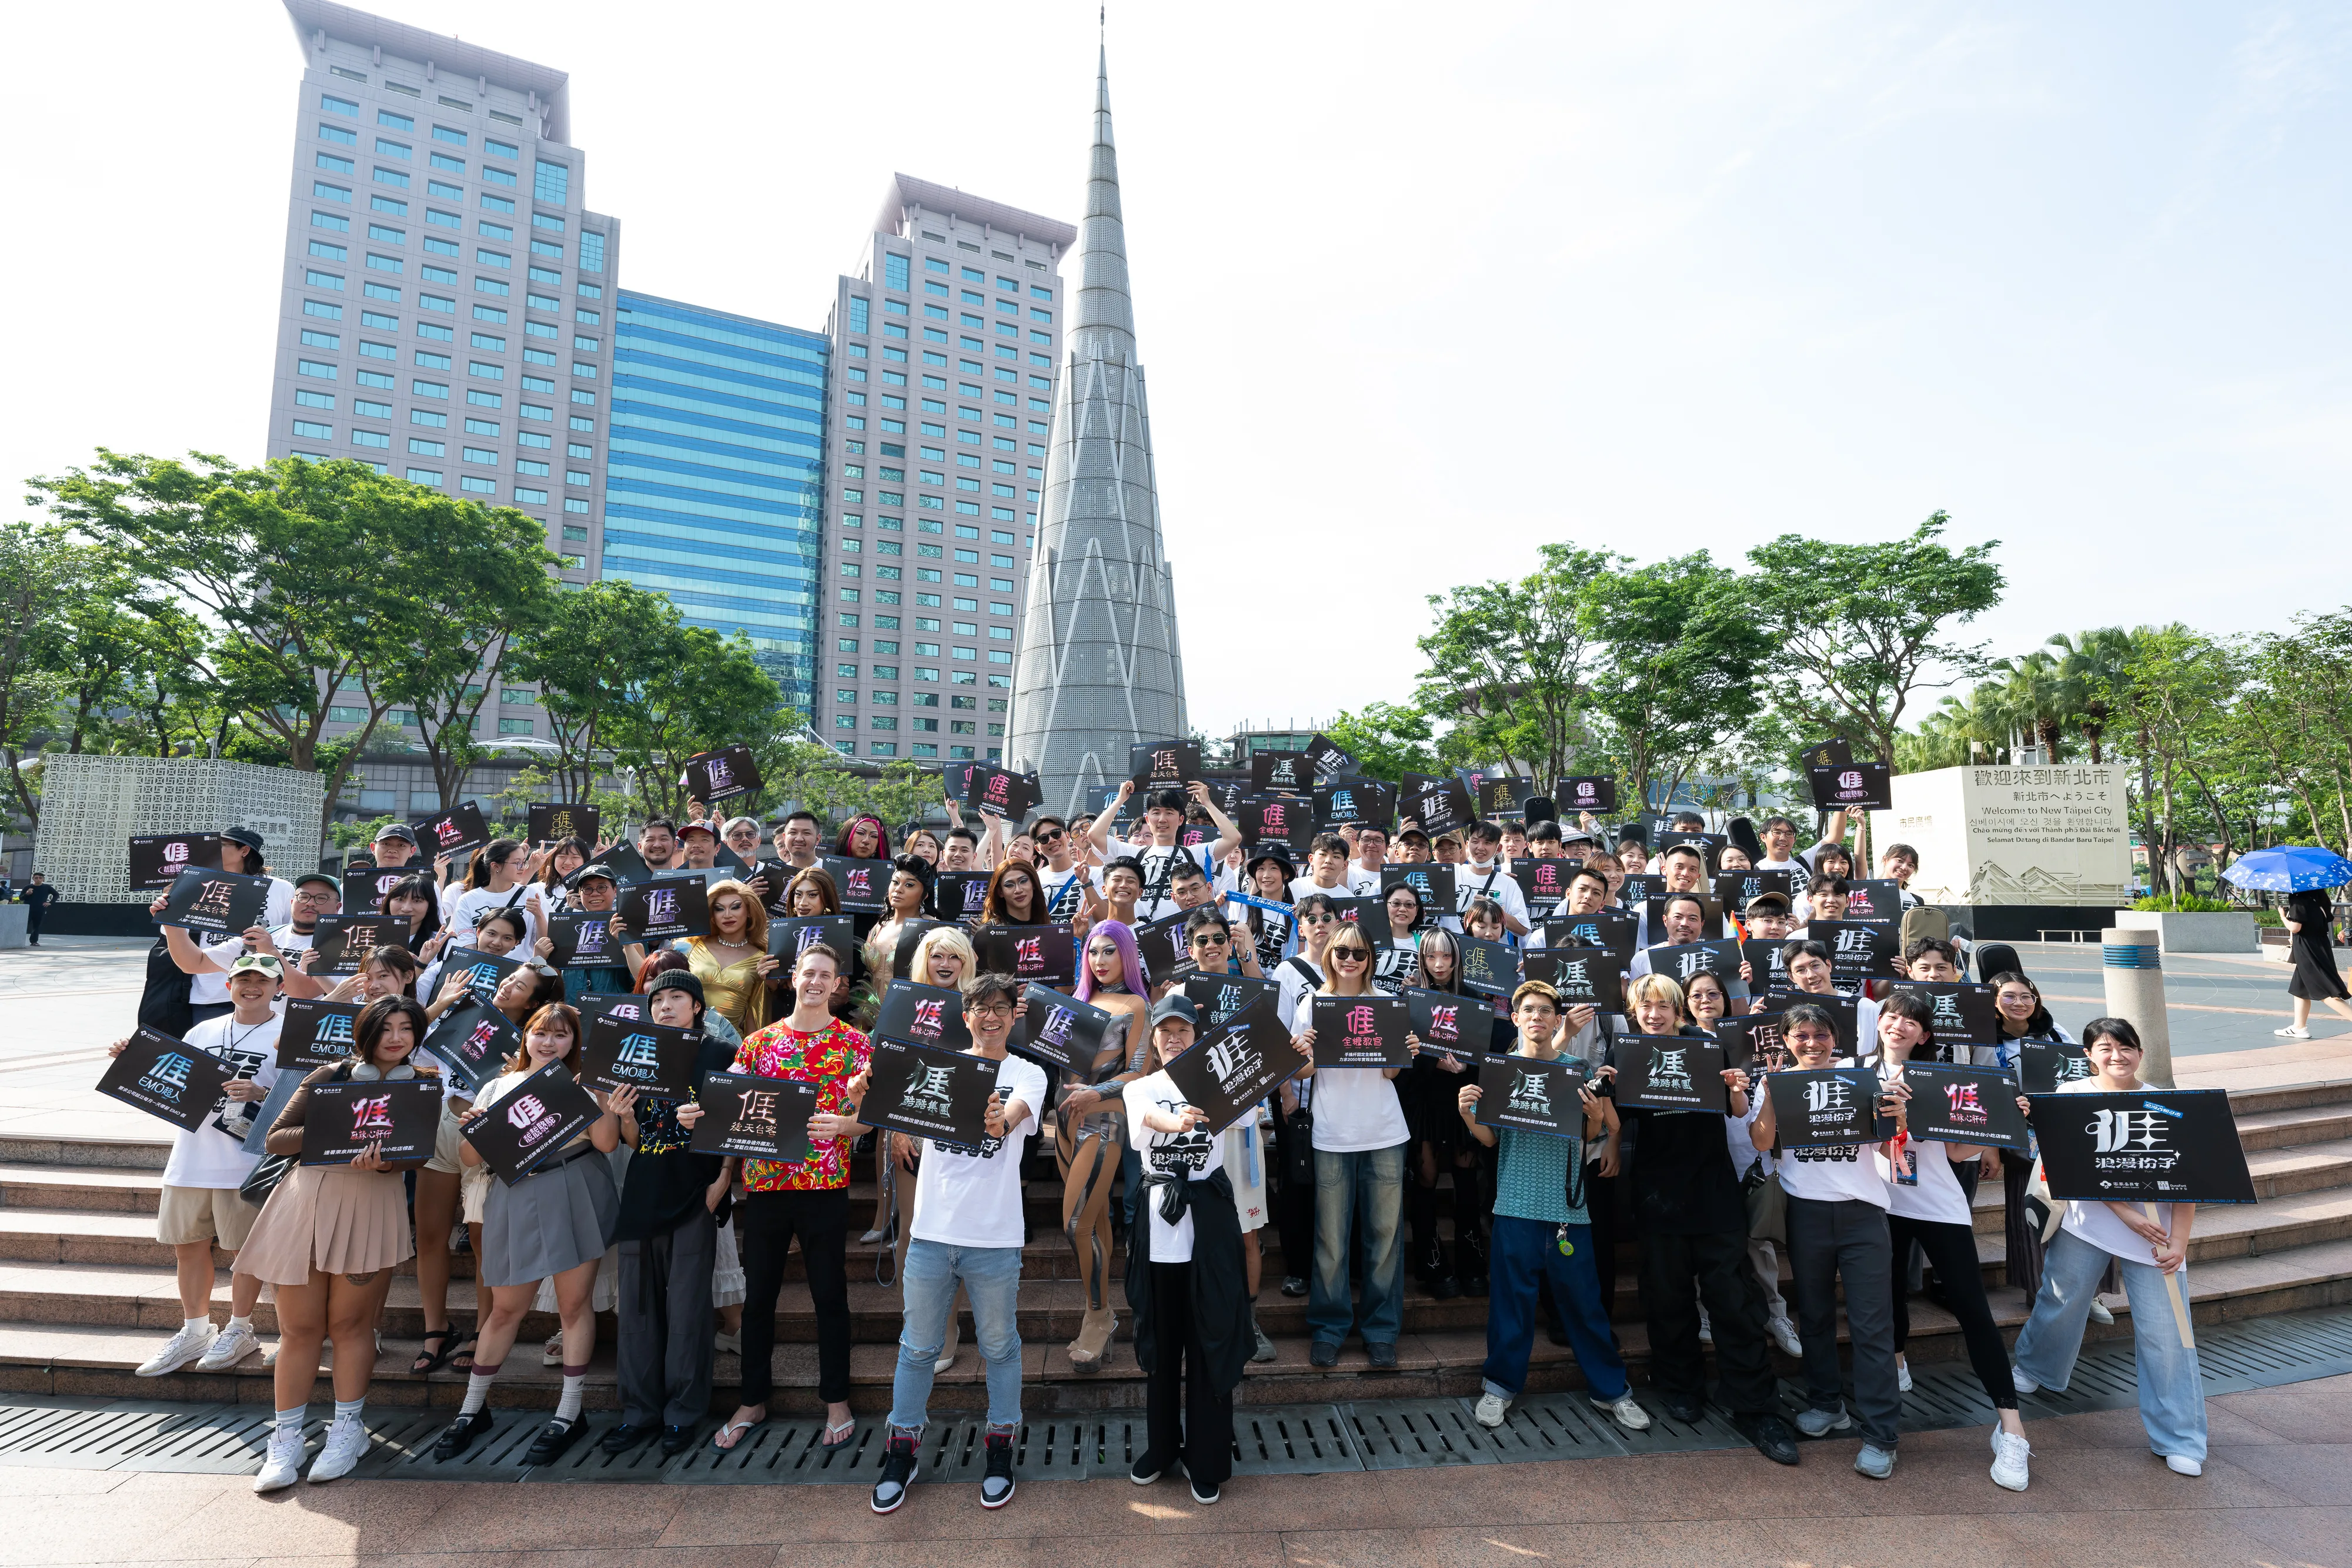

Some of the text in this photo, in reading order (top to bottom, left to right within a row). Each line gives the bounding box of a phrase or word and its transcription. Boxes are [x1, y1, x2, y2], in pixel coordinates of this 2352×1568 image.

[1975, 769, 2111, 786] 歡迎來到新北市
[2013, 791, 2107, 801] 新北市へようこそ
[2064, 807, 2092, 816] Taipei
[2094, 807, 2112, 816] City
[249, 821, 287, 835] 市民廣場
[1969, 818, 2014, 826] 신베이시에
[2067, 818, 2112, 826] 환영합니다
[1532, 885, 1562, 894] 全糖教官
[189, 902, 229, 916] 後天台客
[1342, 1037, 1382, 1046] 全糖教官
[612, 1063, 658, 1081] EMO超人
[1646, 1077, 1693, 1092] 酷酷集團
[1506, 1098, 1552, 1116] 酷酷集團
[1809, 1112, 1856, 1124] 浪漫份子
[1949, 1112, 1987, 1125] 麻辣心肝仔
[729, 1122, 777, 1136] 後天台客
[2095, 1157, 2177, 1169] 浪漫份子
